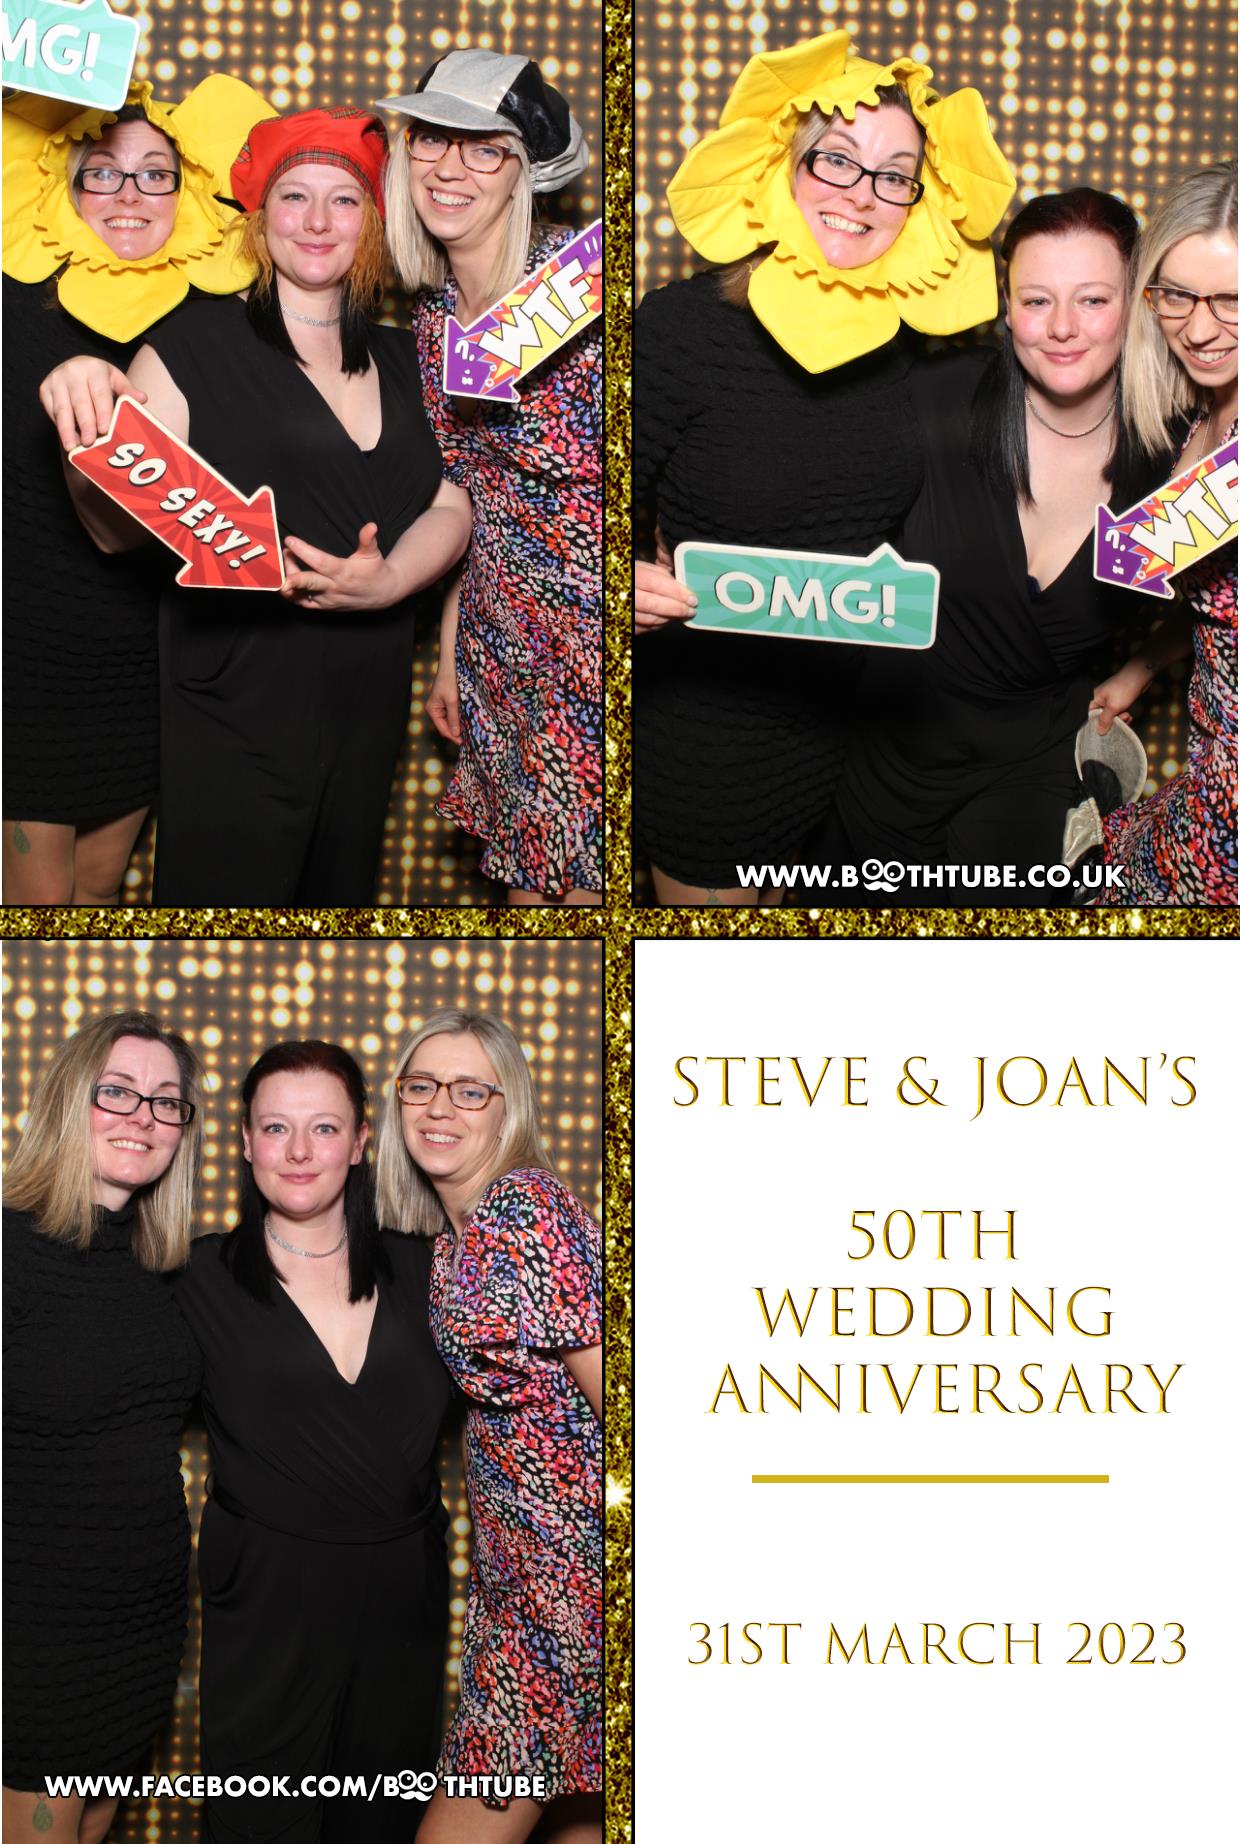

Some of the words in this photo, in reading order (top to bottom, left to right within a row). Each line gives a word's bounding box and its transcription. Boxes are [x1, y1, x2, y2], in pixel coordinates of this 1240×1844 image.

[477, 256, 593, 369] WTF
[107, 443, 167, 486] SO
[159, 487, 267, 569] SEXY!
[714, 572, 897, 628] OMG!
